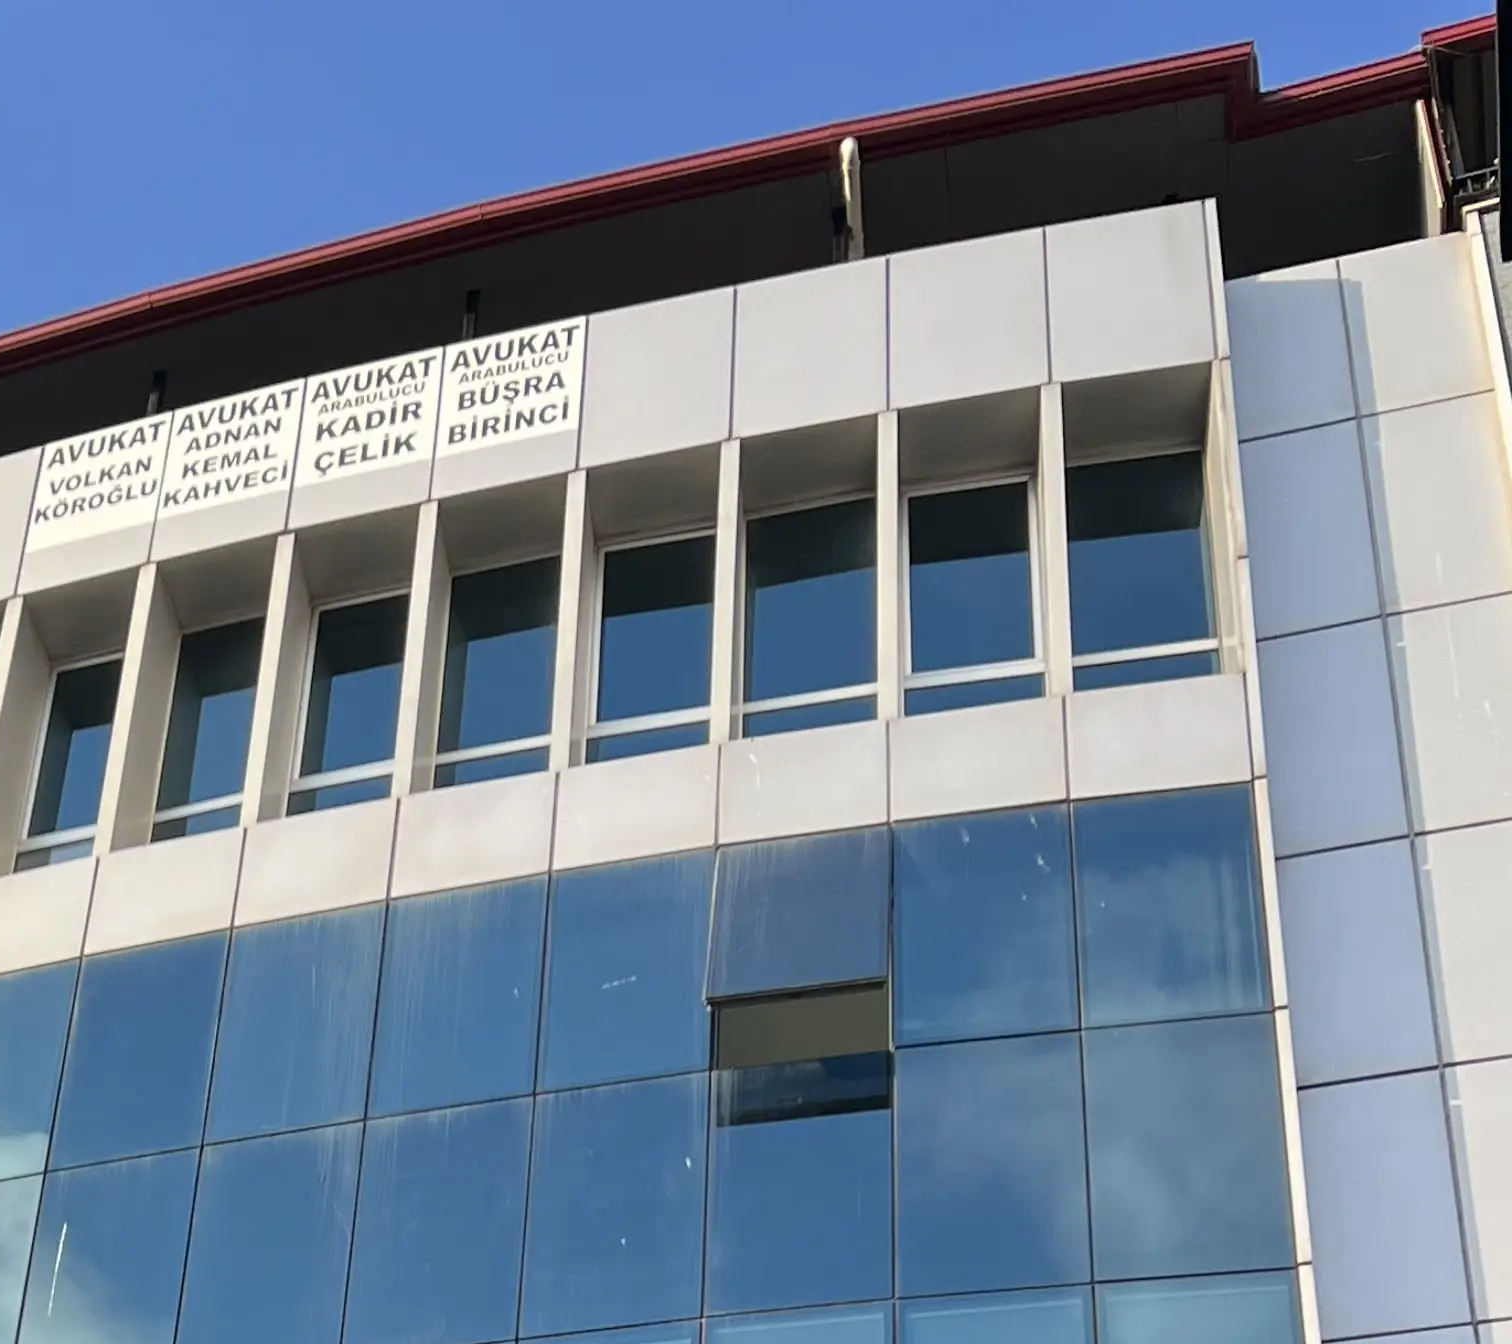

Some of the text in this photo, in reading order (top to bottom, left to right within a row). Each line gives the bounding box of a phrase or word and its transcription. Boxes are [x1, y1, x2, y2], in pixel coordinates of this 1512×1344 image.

[450, 325, 580, 373] AVUKAT
[459, 351, 570, 384] ARABULUCU
[310, 356, 437, 404] AVUKAT
[318, 381, 426, 415] ARABULUCU
[457, 371, 566, 412] BÜŞRA
[177, 388, 299, 436] AVUKAT
[315, 400, 423, 442] KADİR
[448, 401, 570, 445] BİRİNCİ
[48, 421, 166, 469] AVUKAT
[185, 417, 283, 455] ADNAN
[313, 432, 418, 476] ÇELİK
[49, 455, 153, 496] VOLKAN
[182, 442, 278, 479] KEMAL
[34, 478, 158, 525] KÖROĞLU
[163, 461, 289, 508] KAHVECİ
